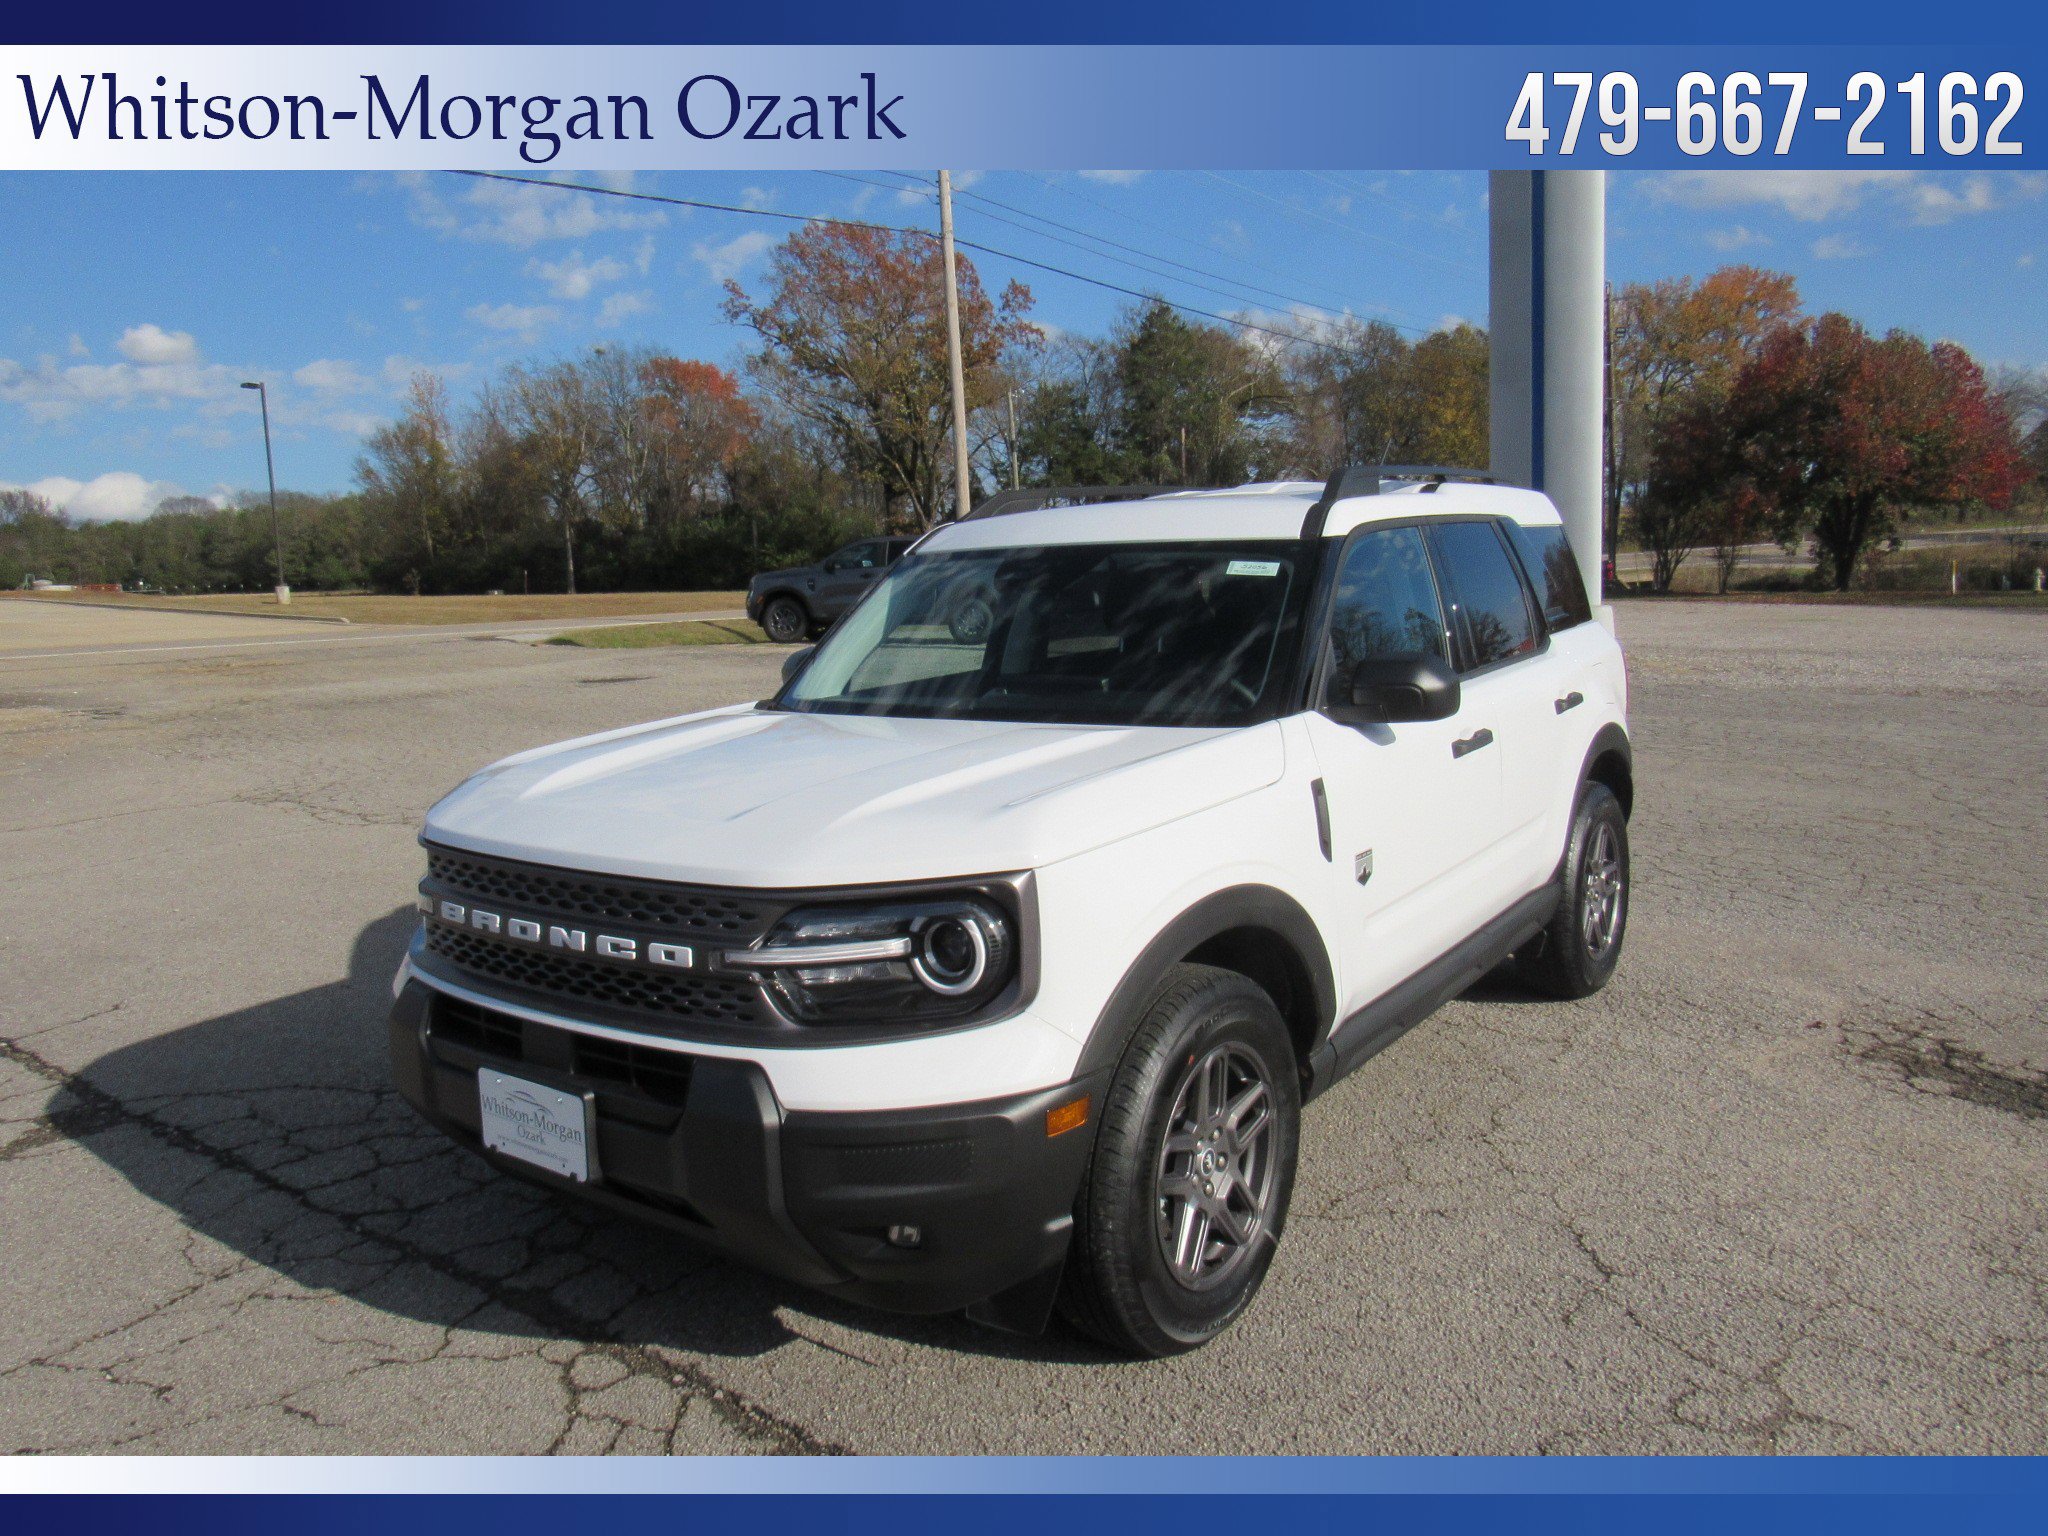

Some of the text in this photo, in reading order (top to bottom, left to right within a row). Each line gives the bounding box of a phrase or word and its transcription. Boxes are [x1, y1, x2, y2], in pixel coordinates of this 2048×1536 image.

[441, 901, 693, 968] BRONCO
[482, 1095, 582, 1142] Whitson-Morgan
[517, 1125, 546, 1145] Ozark
